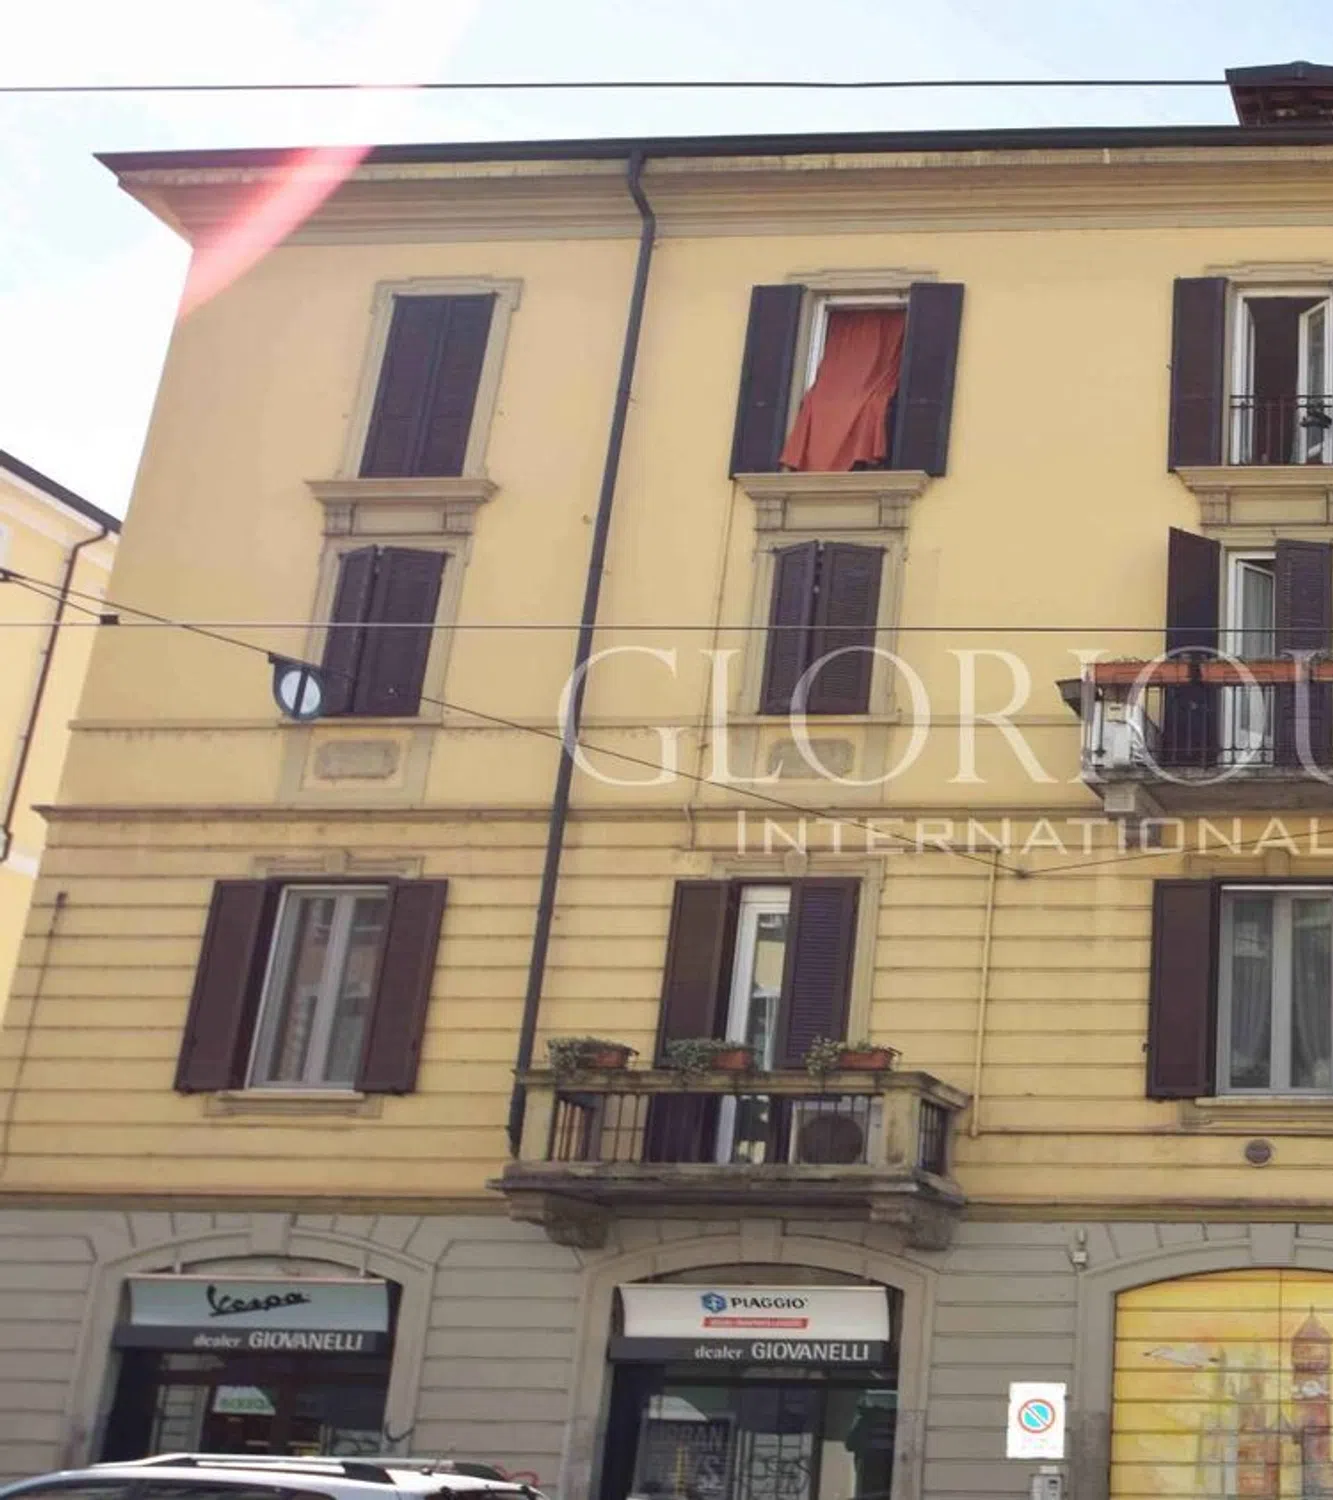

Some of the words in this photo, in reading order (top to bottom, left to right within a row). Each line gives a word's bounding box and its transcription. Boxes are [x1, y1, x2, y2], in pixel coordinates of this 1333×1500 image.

[206, 1284, 312, 1317] Vespa
[730, 1297, 805, 1309] PIAGGIO
[249, 1331, 363, 1350] GIOVANELLI
[695, 1345, 743, 1359] dealer
[752, 1342, 869, 1360] GIOVANELLI
